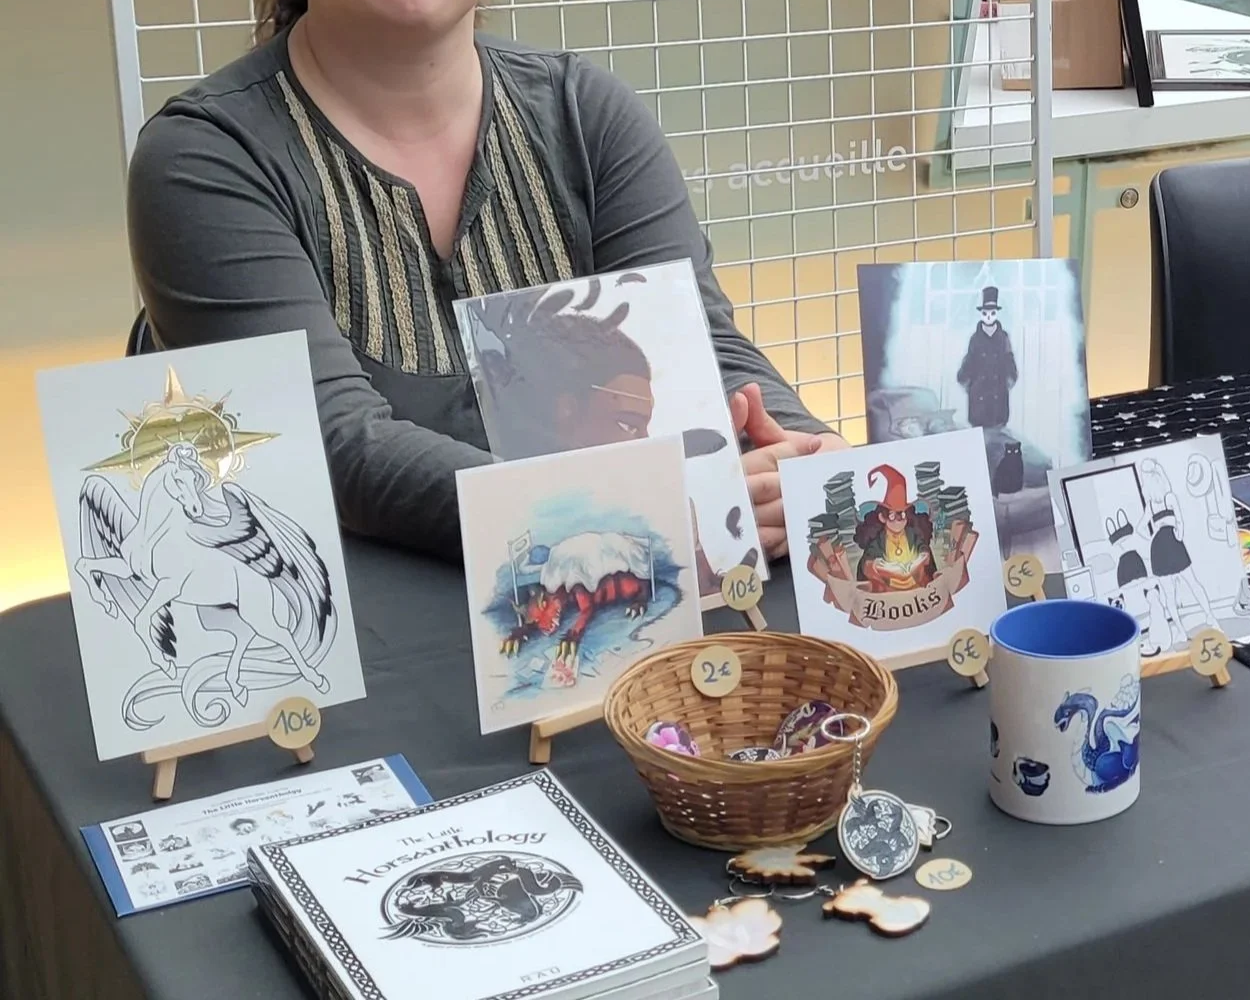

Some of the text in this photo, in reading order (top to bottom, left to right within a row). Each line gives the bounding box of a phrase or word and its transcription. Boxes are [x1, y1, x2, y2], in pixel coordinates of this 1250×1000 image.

[727, 138, 907, 191] accueille
[727, 574, 758, 601] 10€
[1007, 560, 1034, 588] 6€
[860, 586, 942, 622] Books
[952, 636, 981, 665] 6€
[1199, 637, 1224, 664] 5€
[702, 660, 733, 684] 2€
[273, 709, 317, 738] 10€
[344, 829, 548, 885] Horsanthology
[927, 863, 966, 885] 10€
